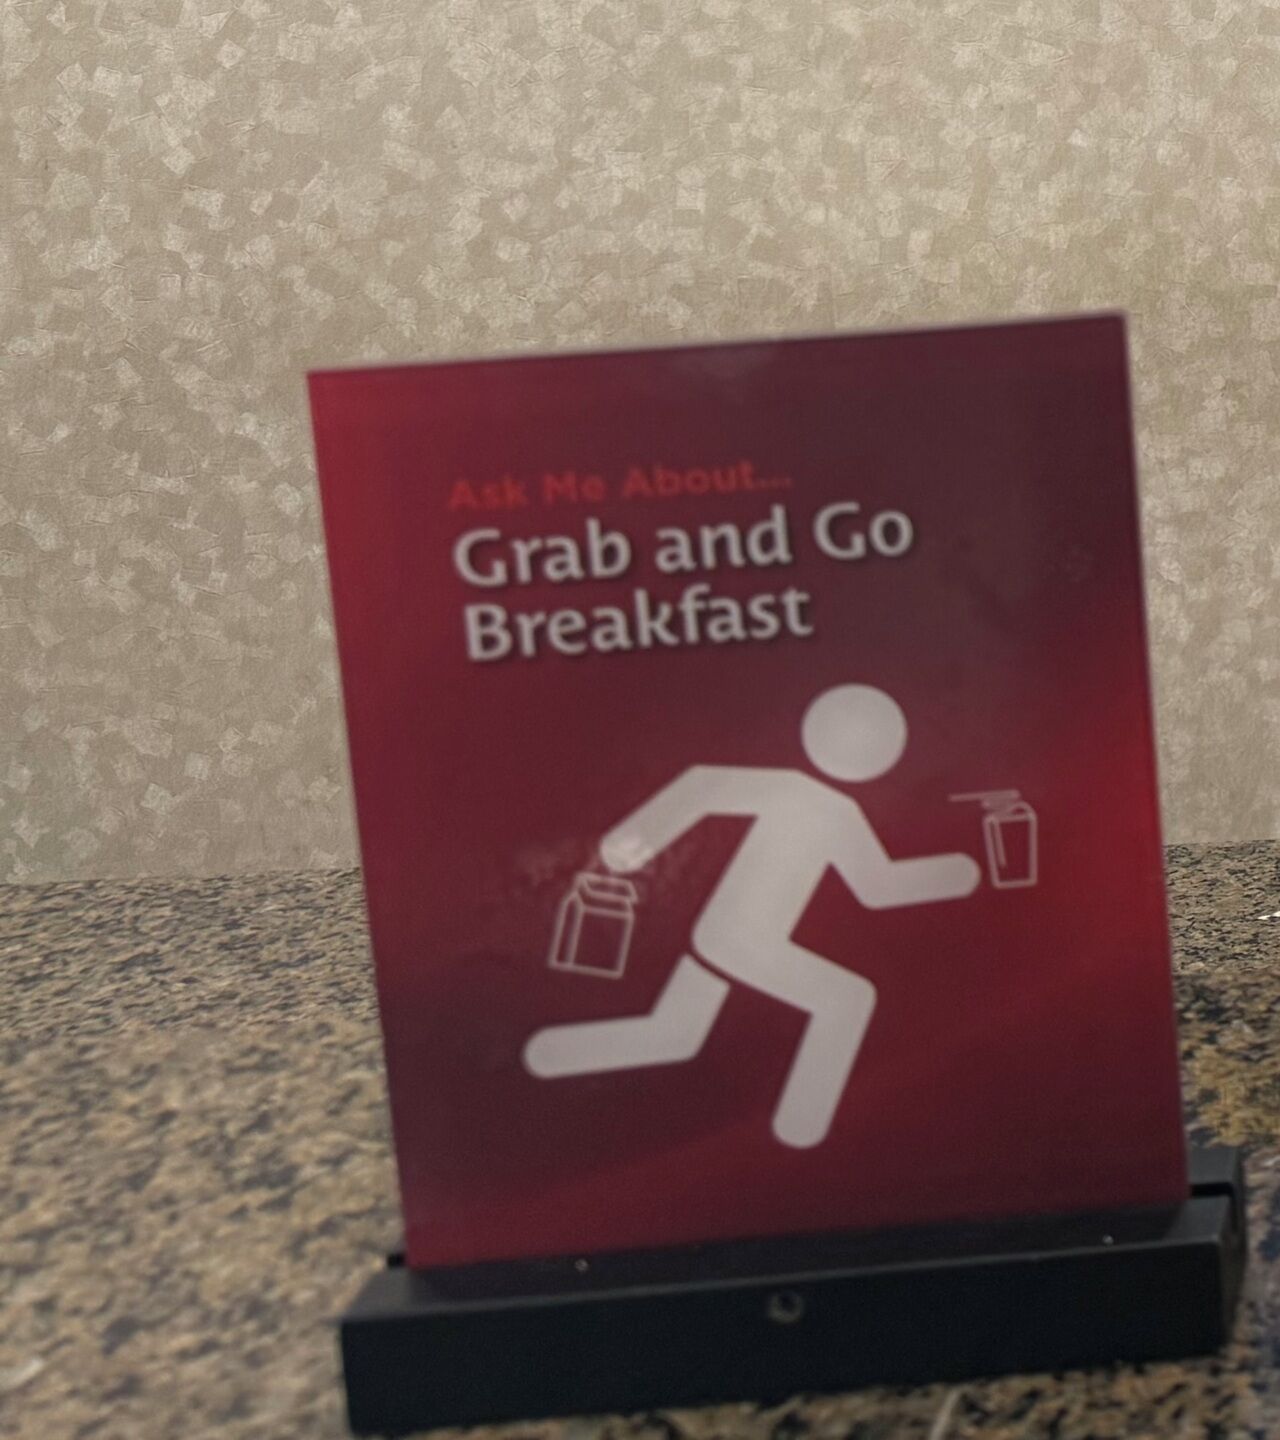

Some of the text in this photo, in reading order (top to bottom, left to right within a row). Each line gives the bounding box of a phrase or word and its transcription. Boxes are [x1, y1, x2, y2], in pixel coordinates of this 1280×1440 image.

[449, 460, 793, 510] Ask Me About...
[453, 502, 913, 587] Grab and Go
[465, 584, 813, 661] Breakfast
